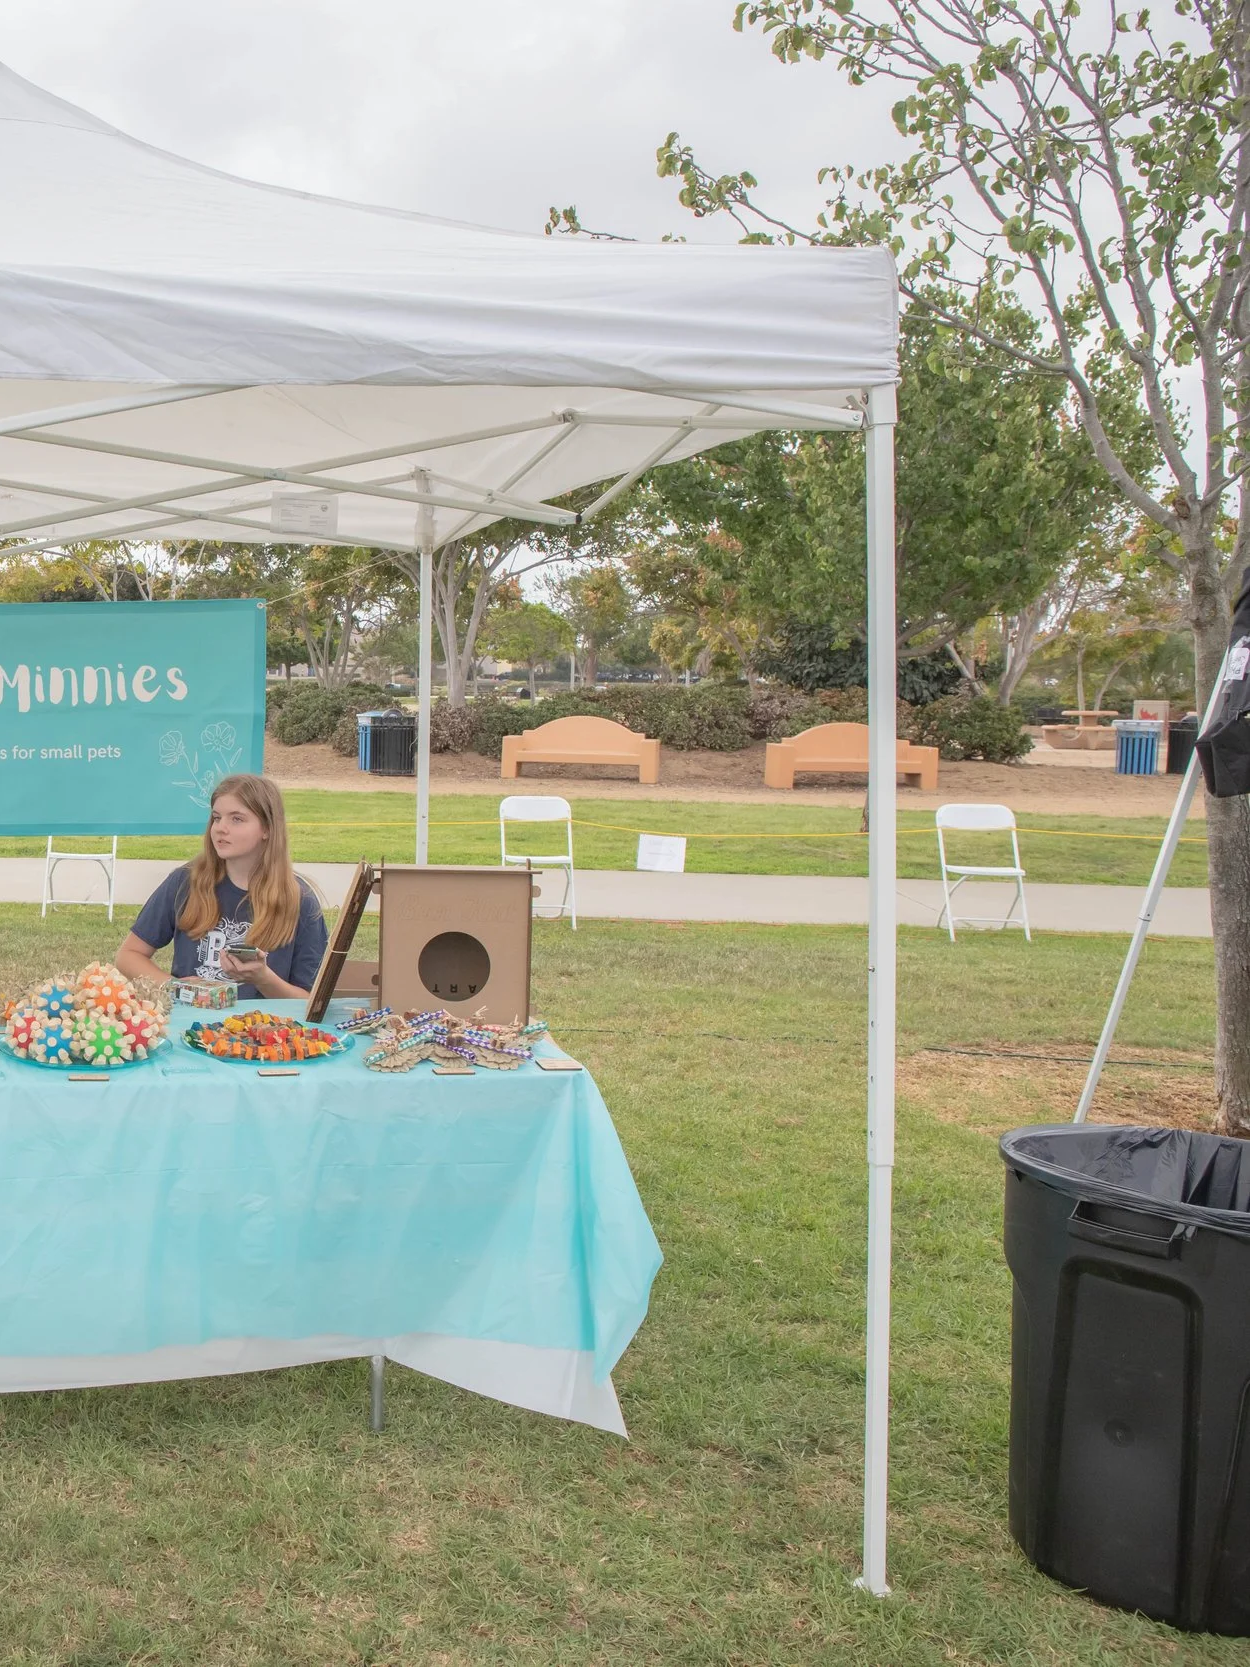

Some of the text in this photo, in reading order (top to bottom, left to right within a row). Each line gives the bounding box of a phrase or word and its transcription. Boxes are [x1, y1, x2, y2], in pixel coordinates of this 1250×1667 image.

[11, 745, 36, 760] for
[40, 744, 83, 759] small
[87, 744, 122, 763] pets
